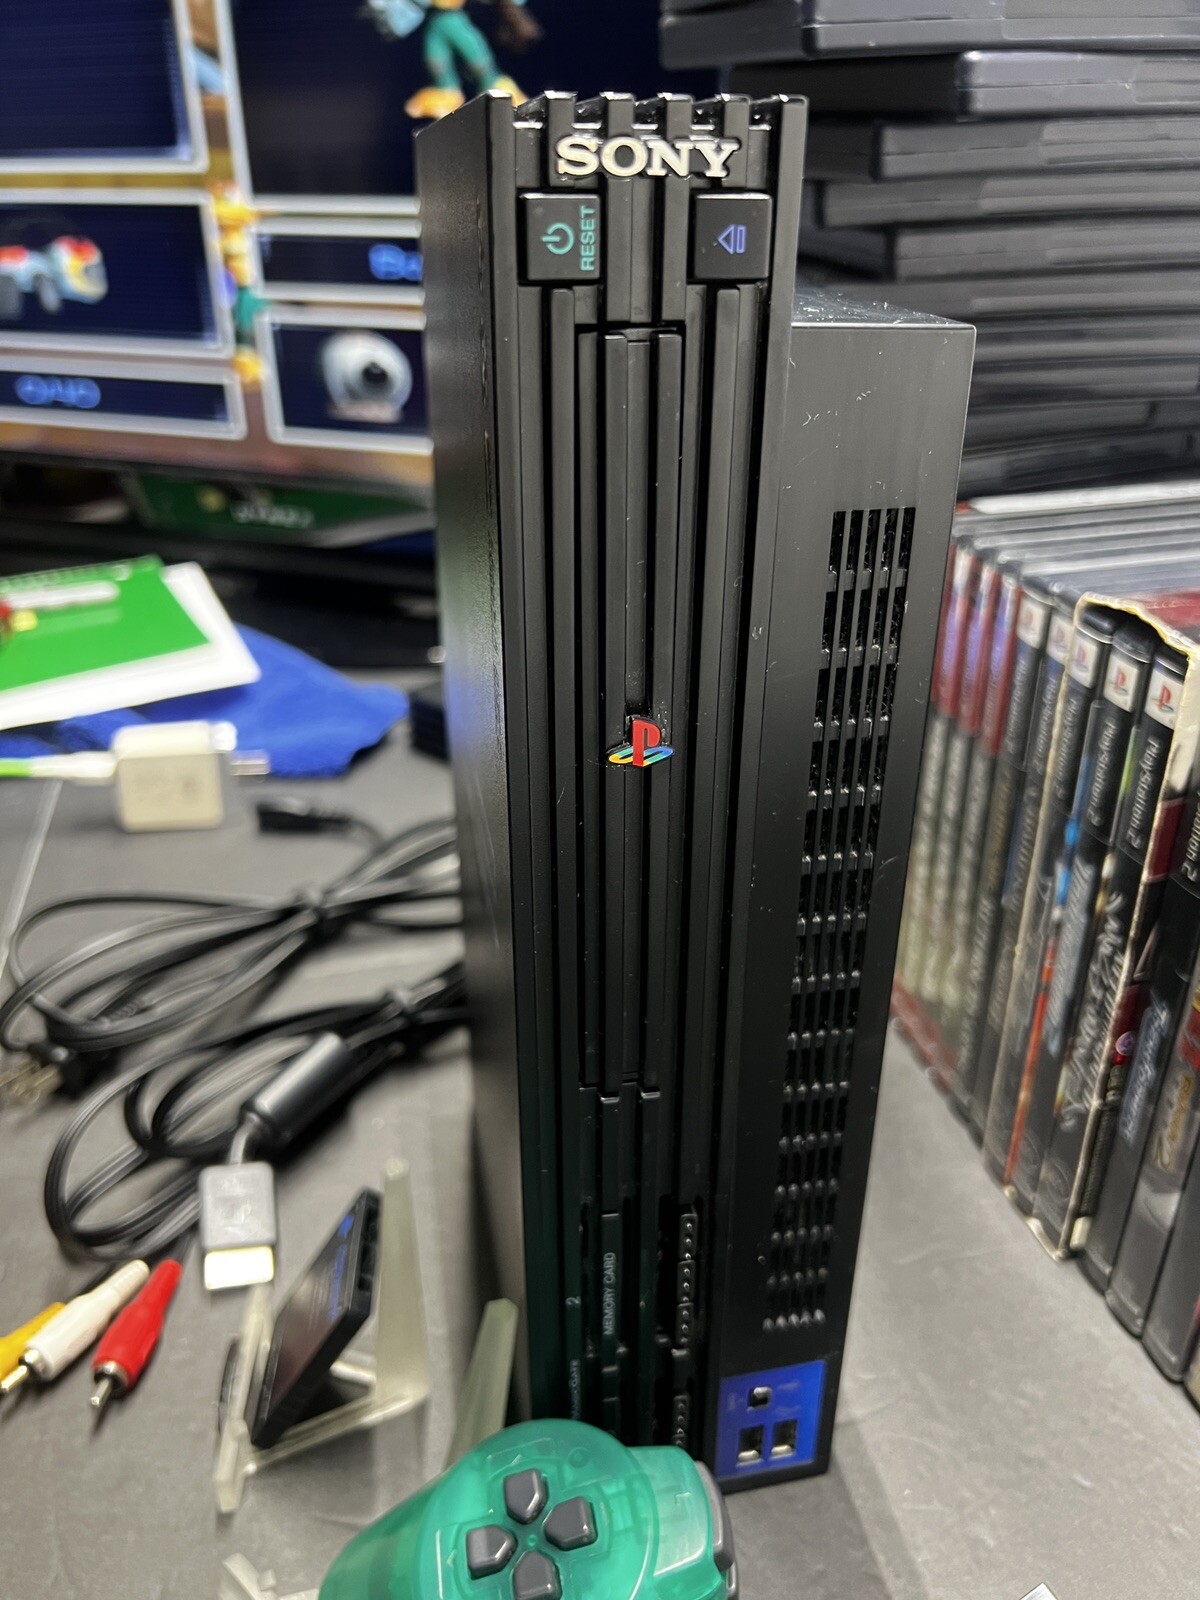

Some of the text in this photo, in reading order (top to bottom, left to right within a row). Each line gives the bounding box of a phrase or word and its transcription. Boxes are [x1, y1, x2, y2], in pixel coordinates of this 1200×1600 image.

[556, 135, 740, 177] SONY
[579, 205, 596, 271] RESET
[1035, 677, 1057, 762] PlayStation
[1057, 698, 1078, 785] PlayStation
[1087, 719, 1119, 828] PlayStation 2
[1126, 735, 1161, 850] PlayStation 2
[1181, 861, 1198, 882] 2
[565, 1296, 582, 1310] 2
[602, 1252, 617, 1335] MEMORY CARD
